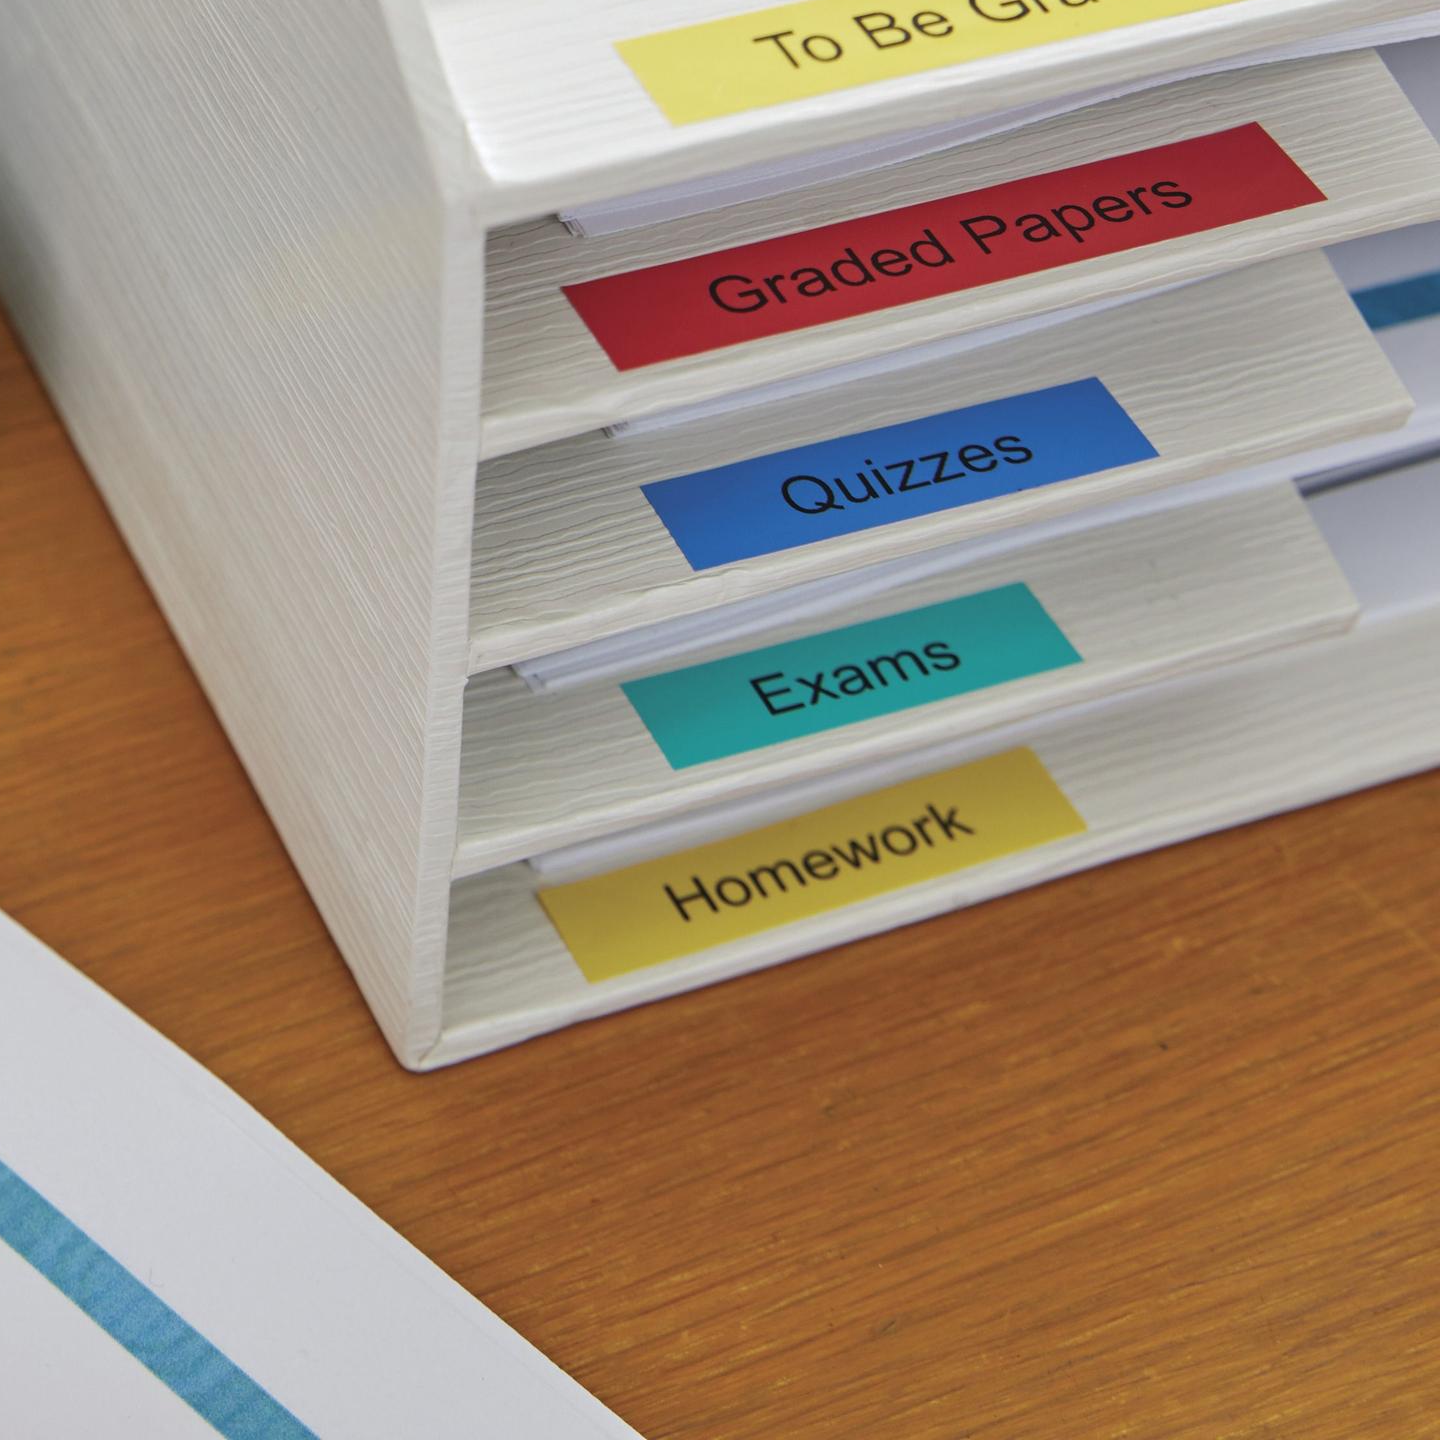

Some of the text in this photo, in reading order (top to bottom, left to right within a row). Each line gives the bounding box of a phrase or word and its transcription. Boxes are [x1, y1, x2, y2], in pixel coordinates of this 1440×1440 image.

[753, 29, 845, 72] To
[851, 3, 956, 52] Be
[707, 174, 1194, 317] Graded Papers
[778, 429, 1035, 516] Quizzes
[749, 634, 962, 717] Exams
[663, 797, 976, 923] Homework
